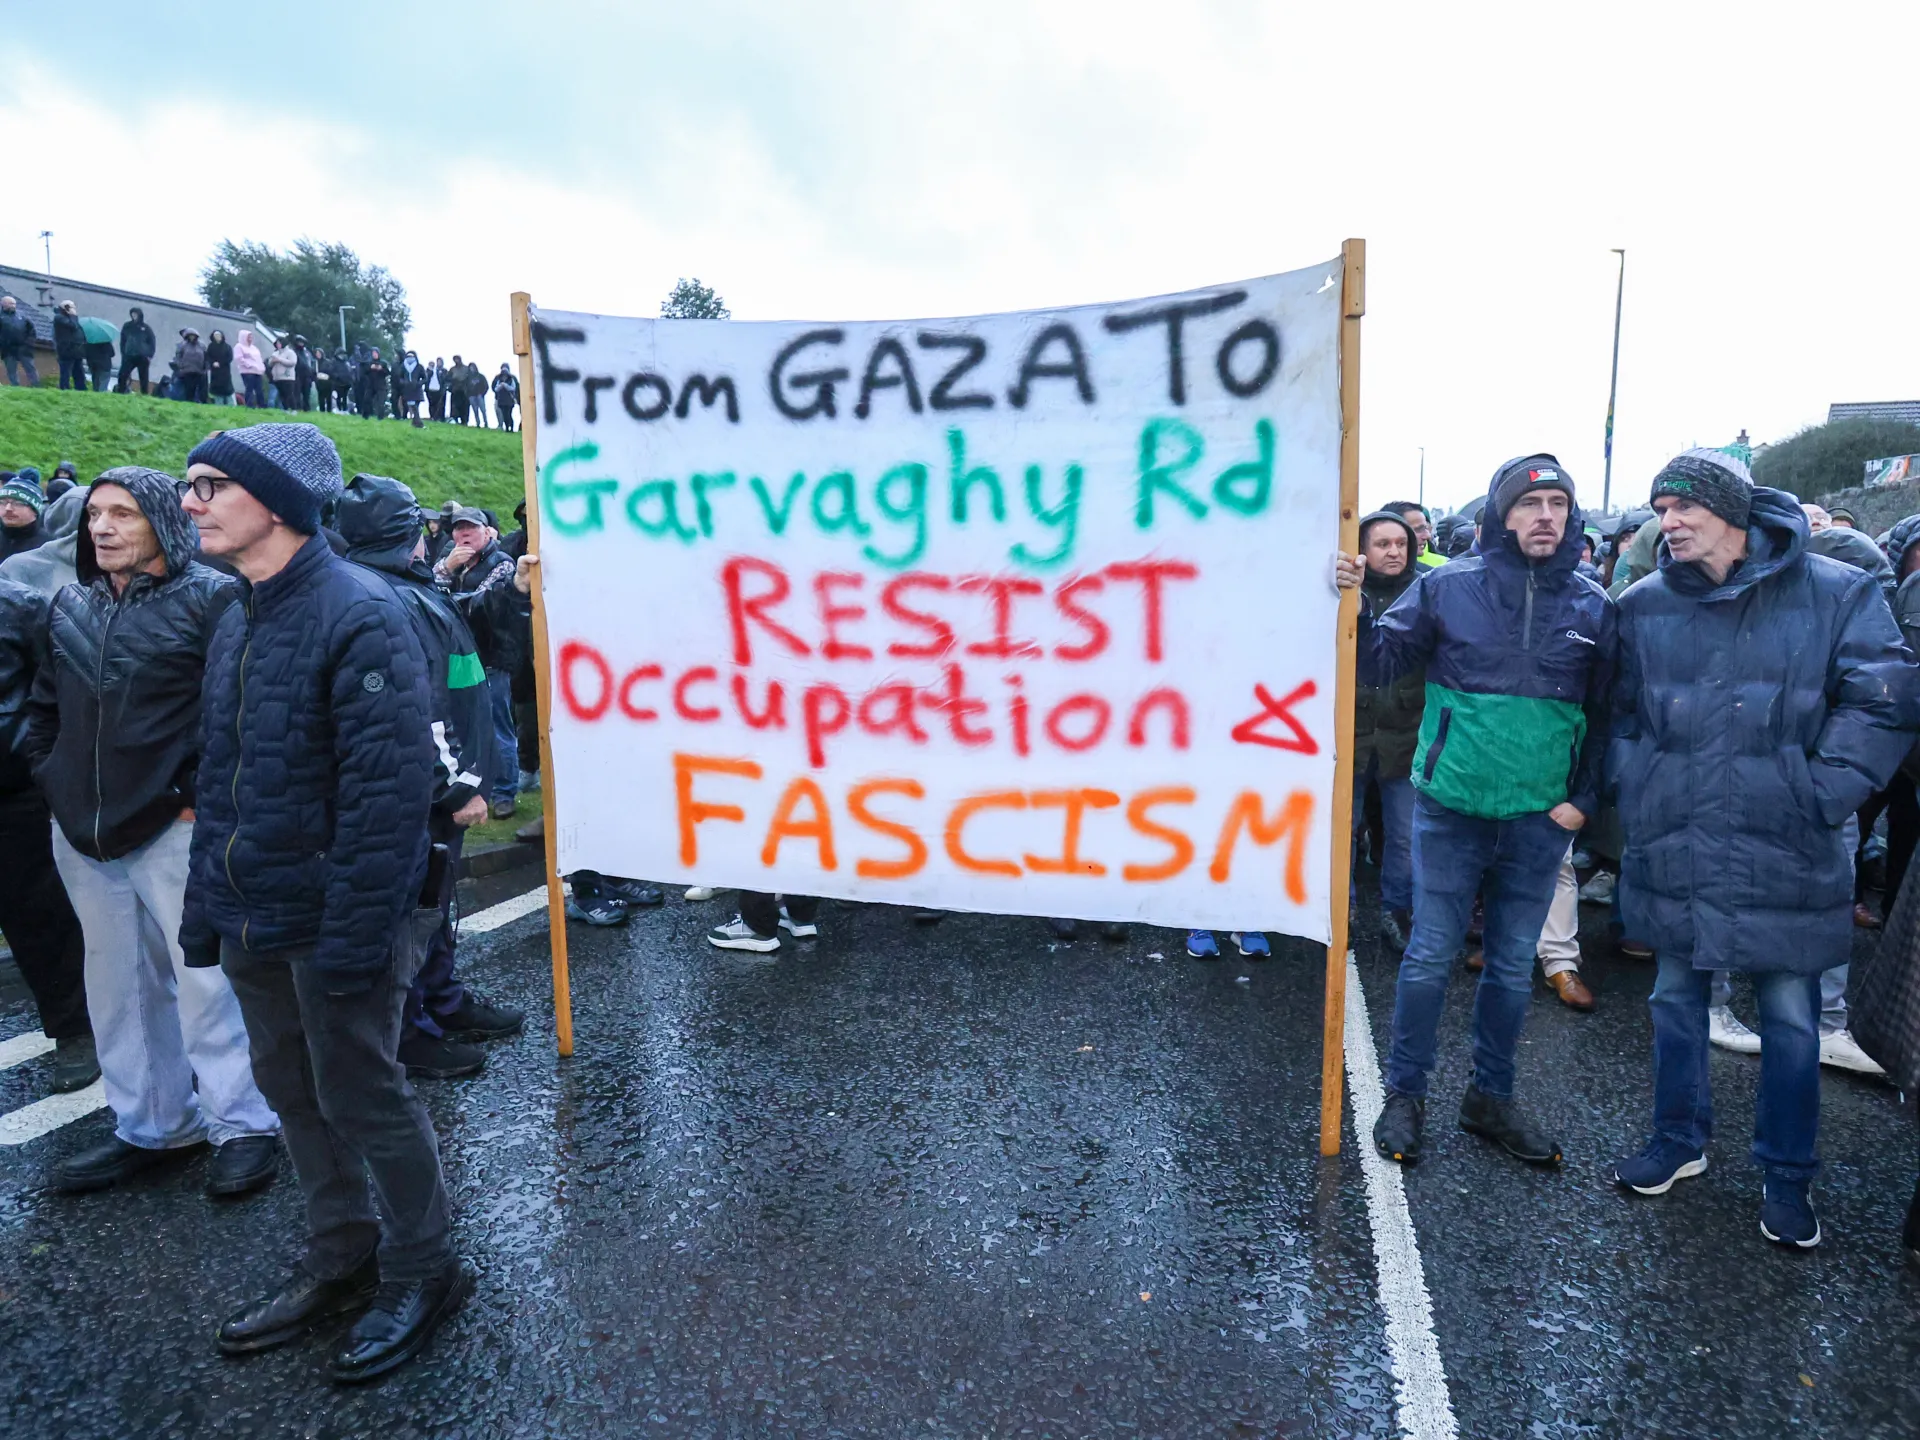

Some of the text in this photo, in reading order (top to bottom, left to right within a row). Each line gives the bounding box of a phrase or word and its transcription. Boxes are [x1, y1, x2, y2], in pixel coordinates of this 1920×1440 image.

[532, 318, 739, 424] From
[768, 325, 1095, 420] GAZA
[540, 415, 1279, 570] Garvaghy Rd
[721, 556, 1198, 668] RESIST
[556, 640, 1189, 769] Occupation
[672, 752, 1316, 905] FASCISM
